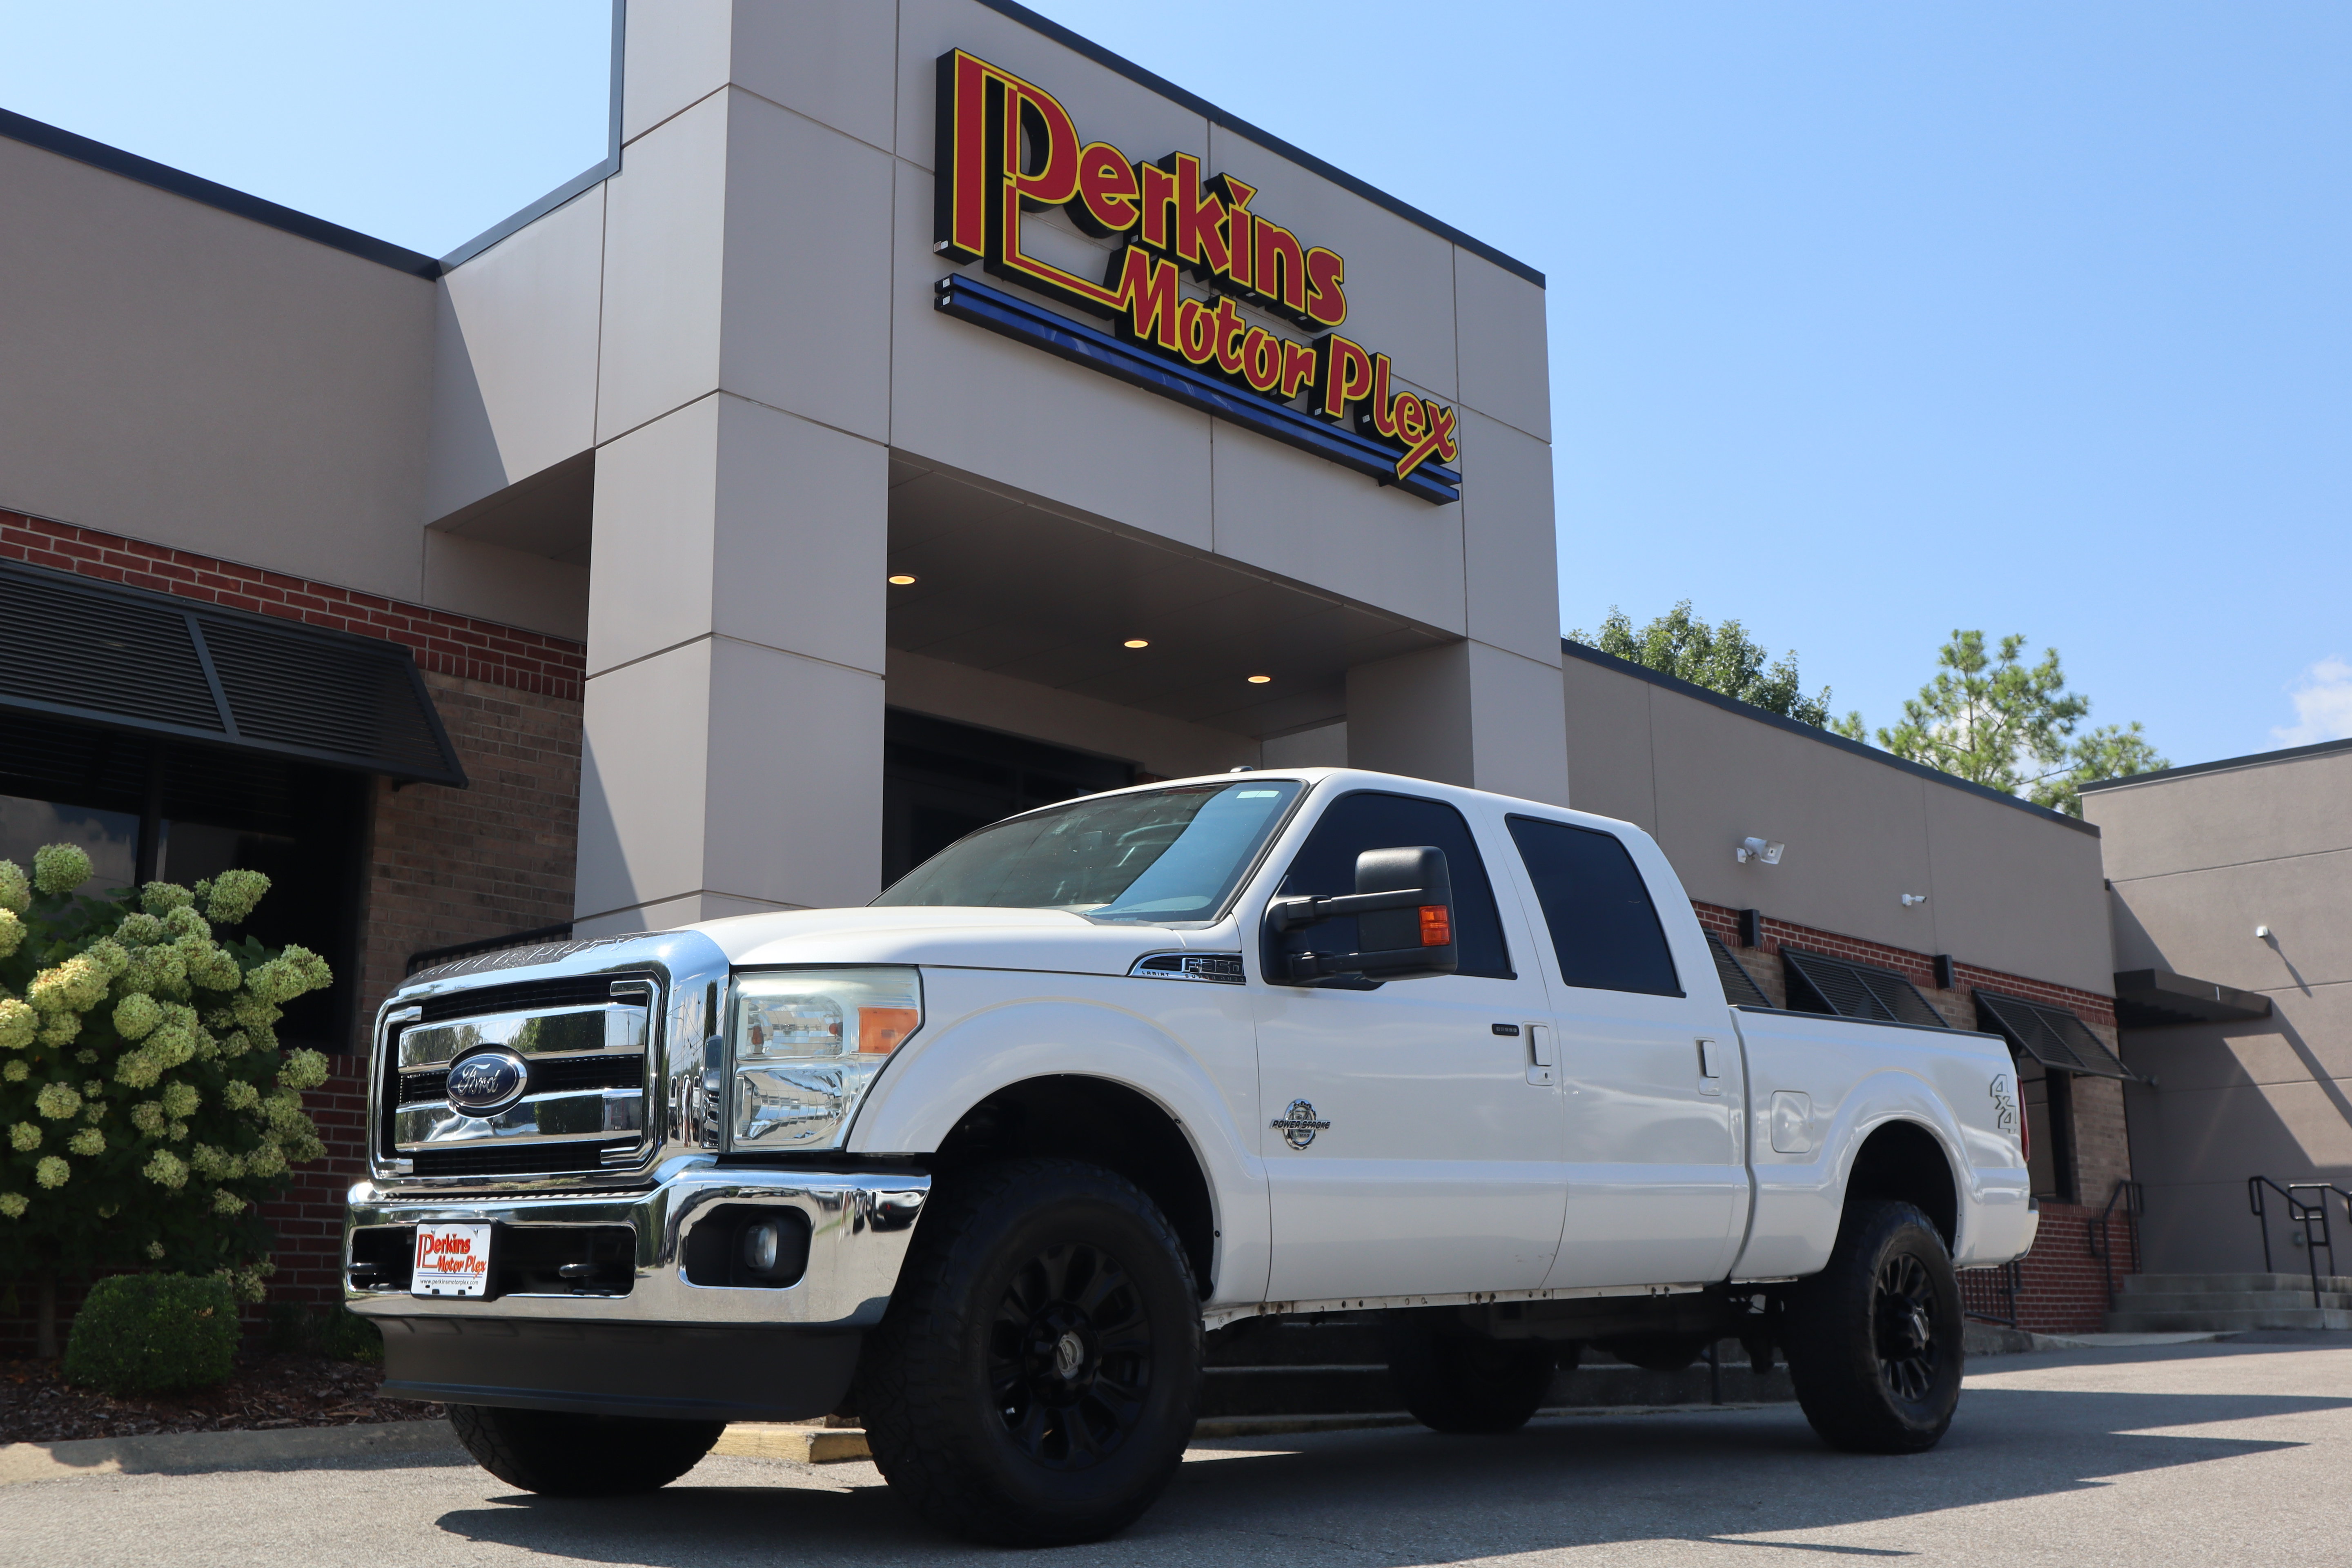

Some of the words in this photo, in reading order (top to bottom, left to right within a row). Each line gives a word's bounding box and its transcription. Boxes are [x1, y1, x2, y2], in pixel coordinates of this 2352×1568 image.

[953, 47, 1348, 327] Perkins
[1117, 245, 1316, 400] Motor
[1325, 333, 1458, 480] Plex
[451, 1063, 501, 1096] Ford
[1272, 1120, 1301, 1129] POWER
[1301, 1121, 1331, 1129] STROKE
[416, 1233, 471, 1268] Perkins
[437, 1254, 464, 1273] Motor
[464, 1255, 487, 1279] Plex
